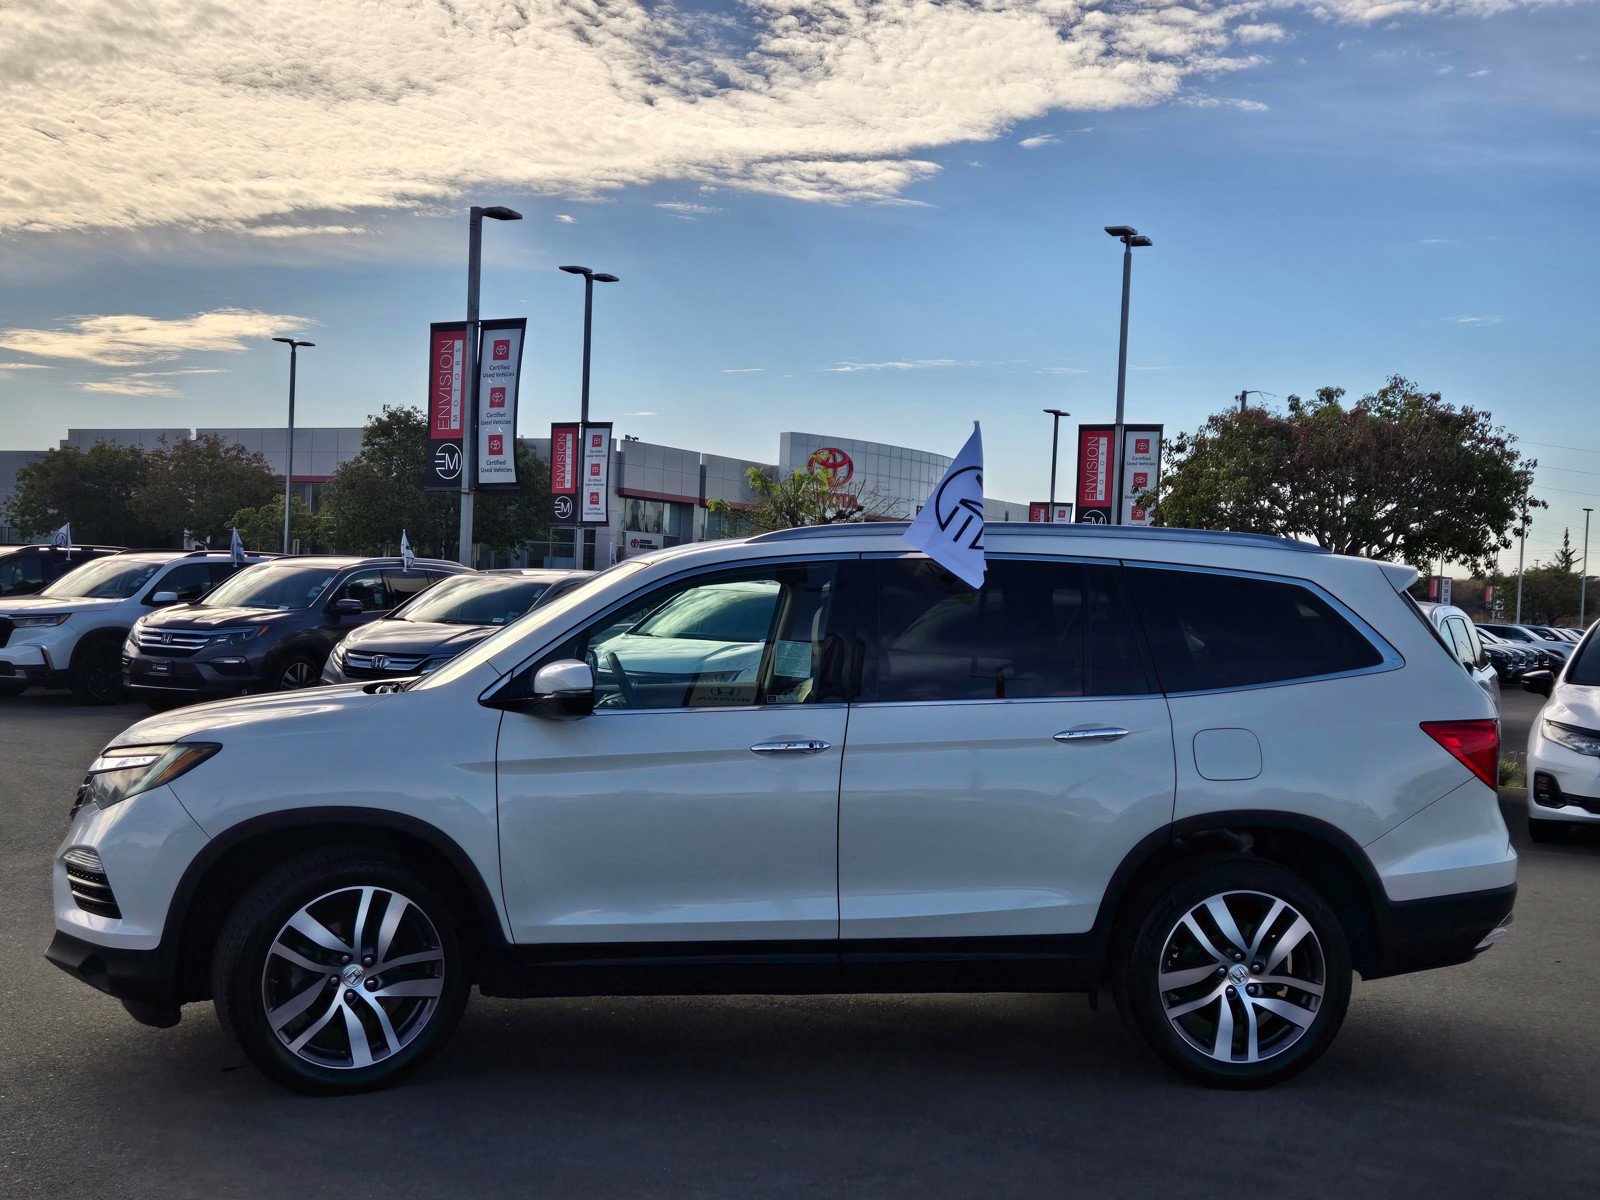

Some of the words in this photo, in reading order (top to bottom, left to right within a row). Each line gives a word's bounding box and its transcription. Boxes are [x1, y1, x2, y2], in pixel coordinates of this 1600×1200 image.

[438, 339, 454, 430] ENVISION
[452, 347, 461, 423] MOTORS
[556, 433, 566, 489] ENVISION
[1085, 436, 1099, 501] ENVISION
